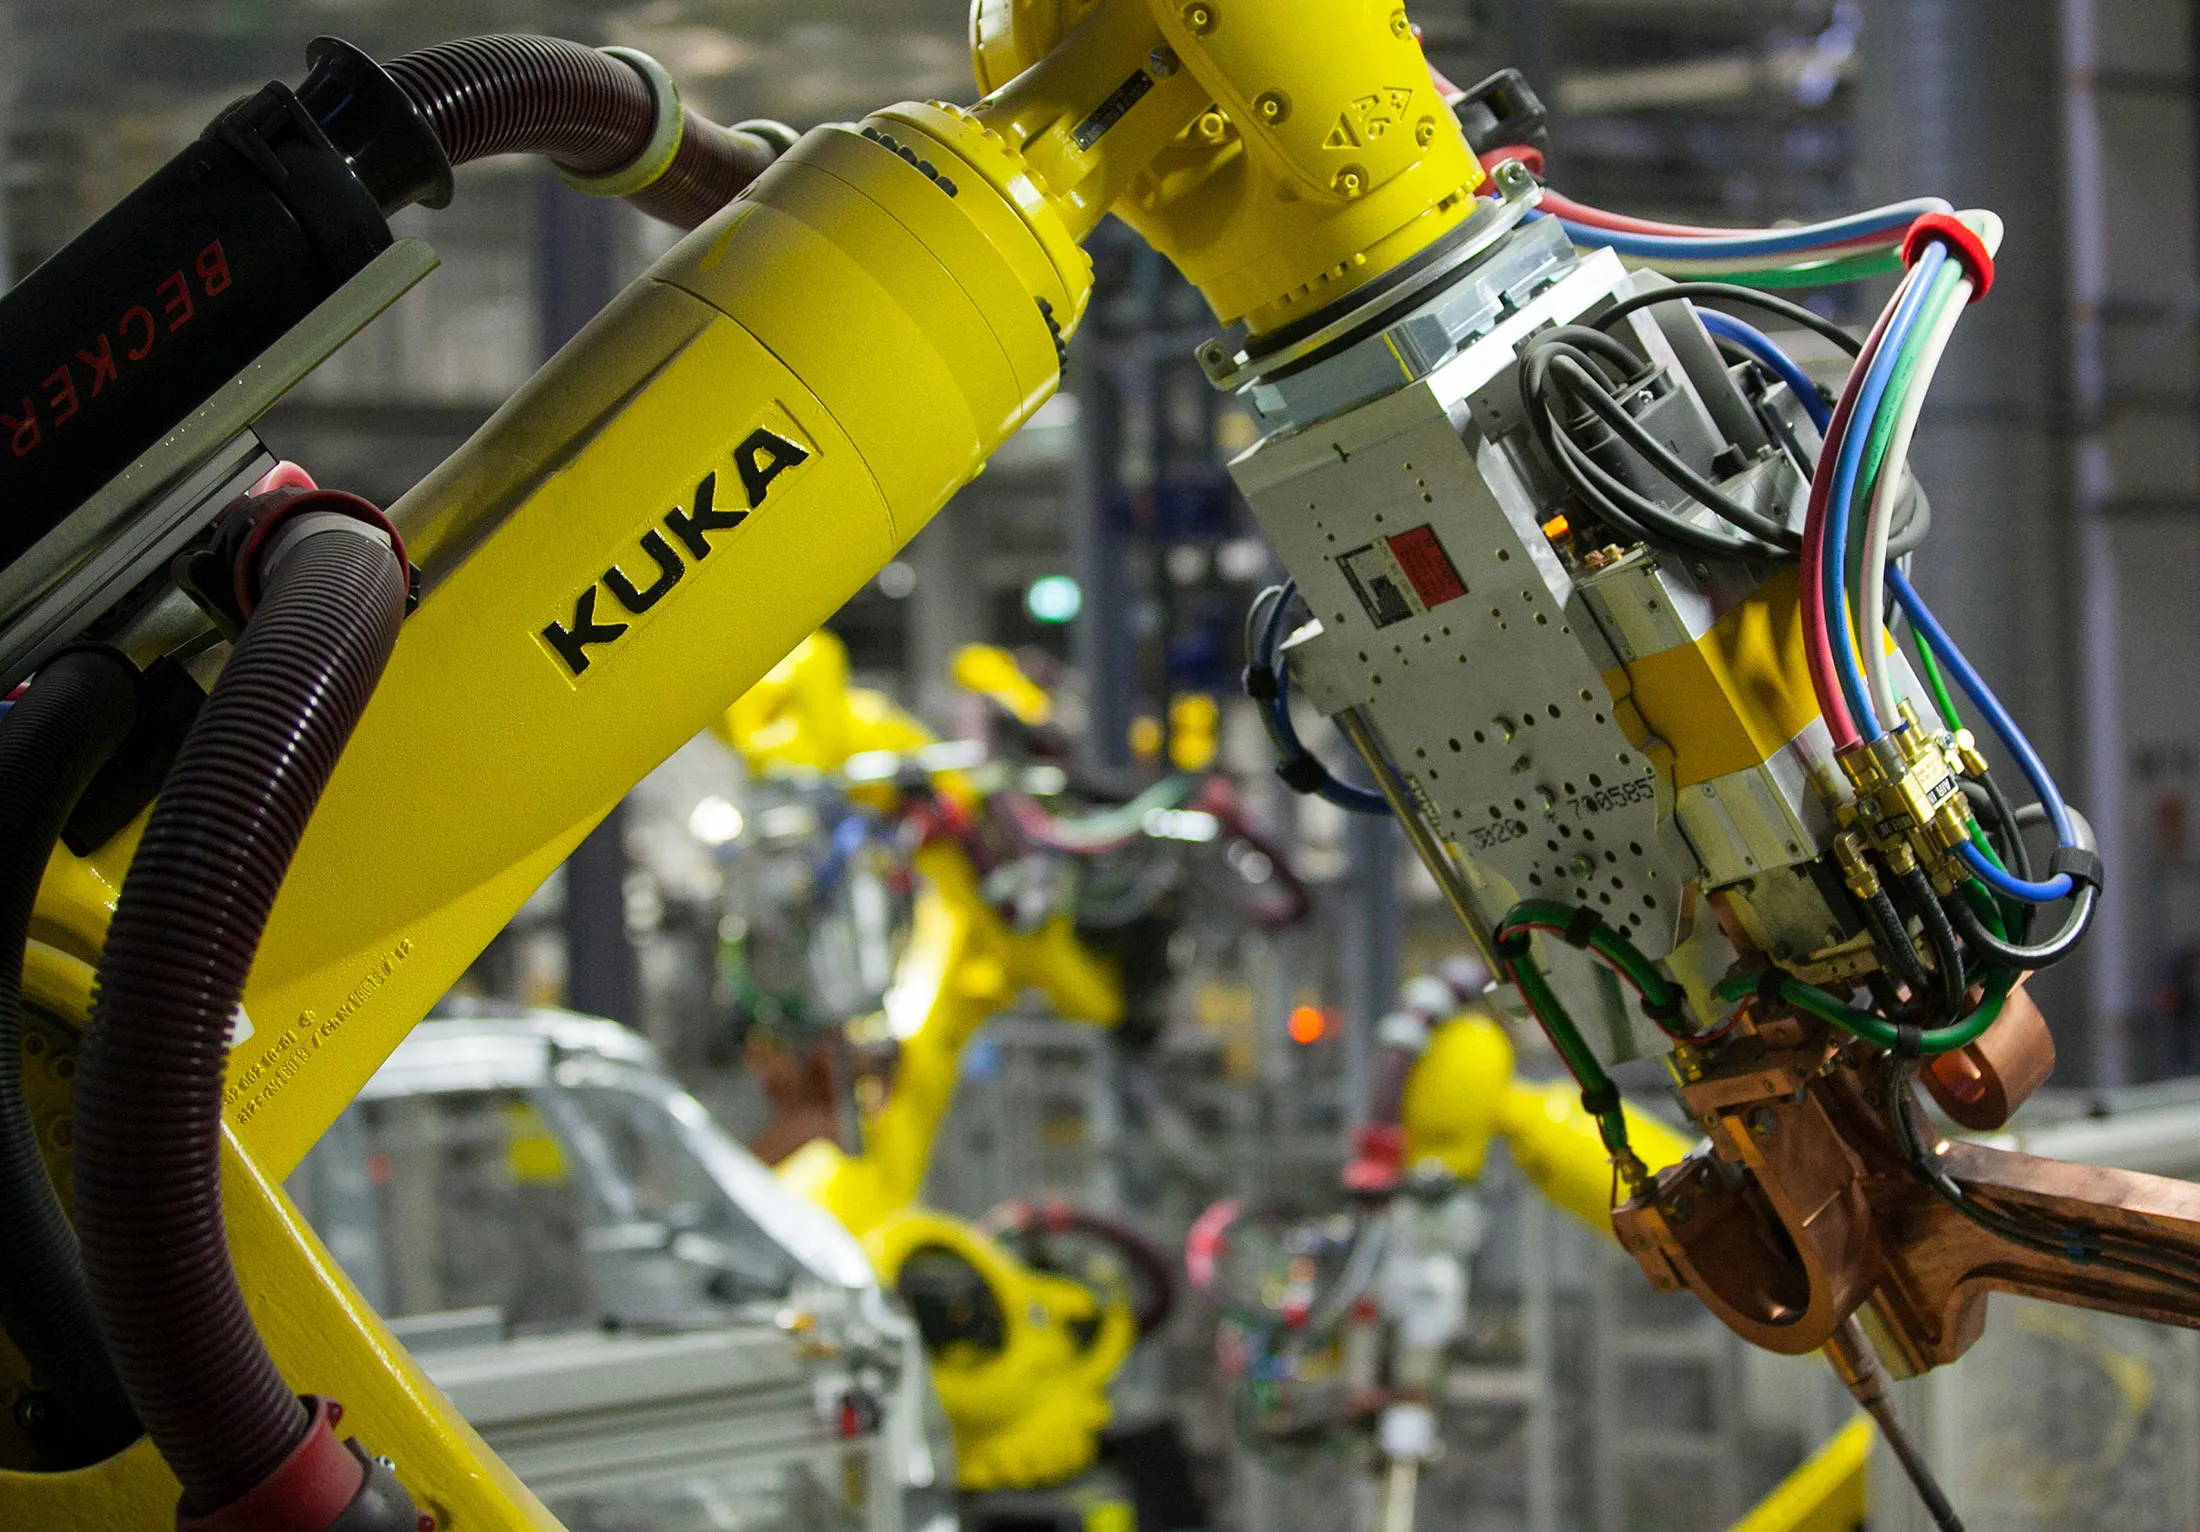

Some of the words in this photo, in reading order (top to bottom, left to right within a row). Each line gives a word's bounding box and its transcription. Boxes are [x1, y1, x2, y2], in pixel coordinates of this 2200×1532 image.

[2, 238, 232, 457] BECKER
[542, 426, 809, 676] KUKA
[1568, 775, 1656, 820] 70585
[1935, 778, 1951, 797] AIR
